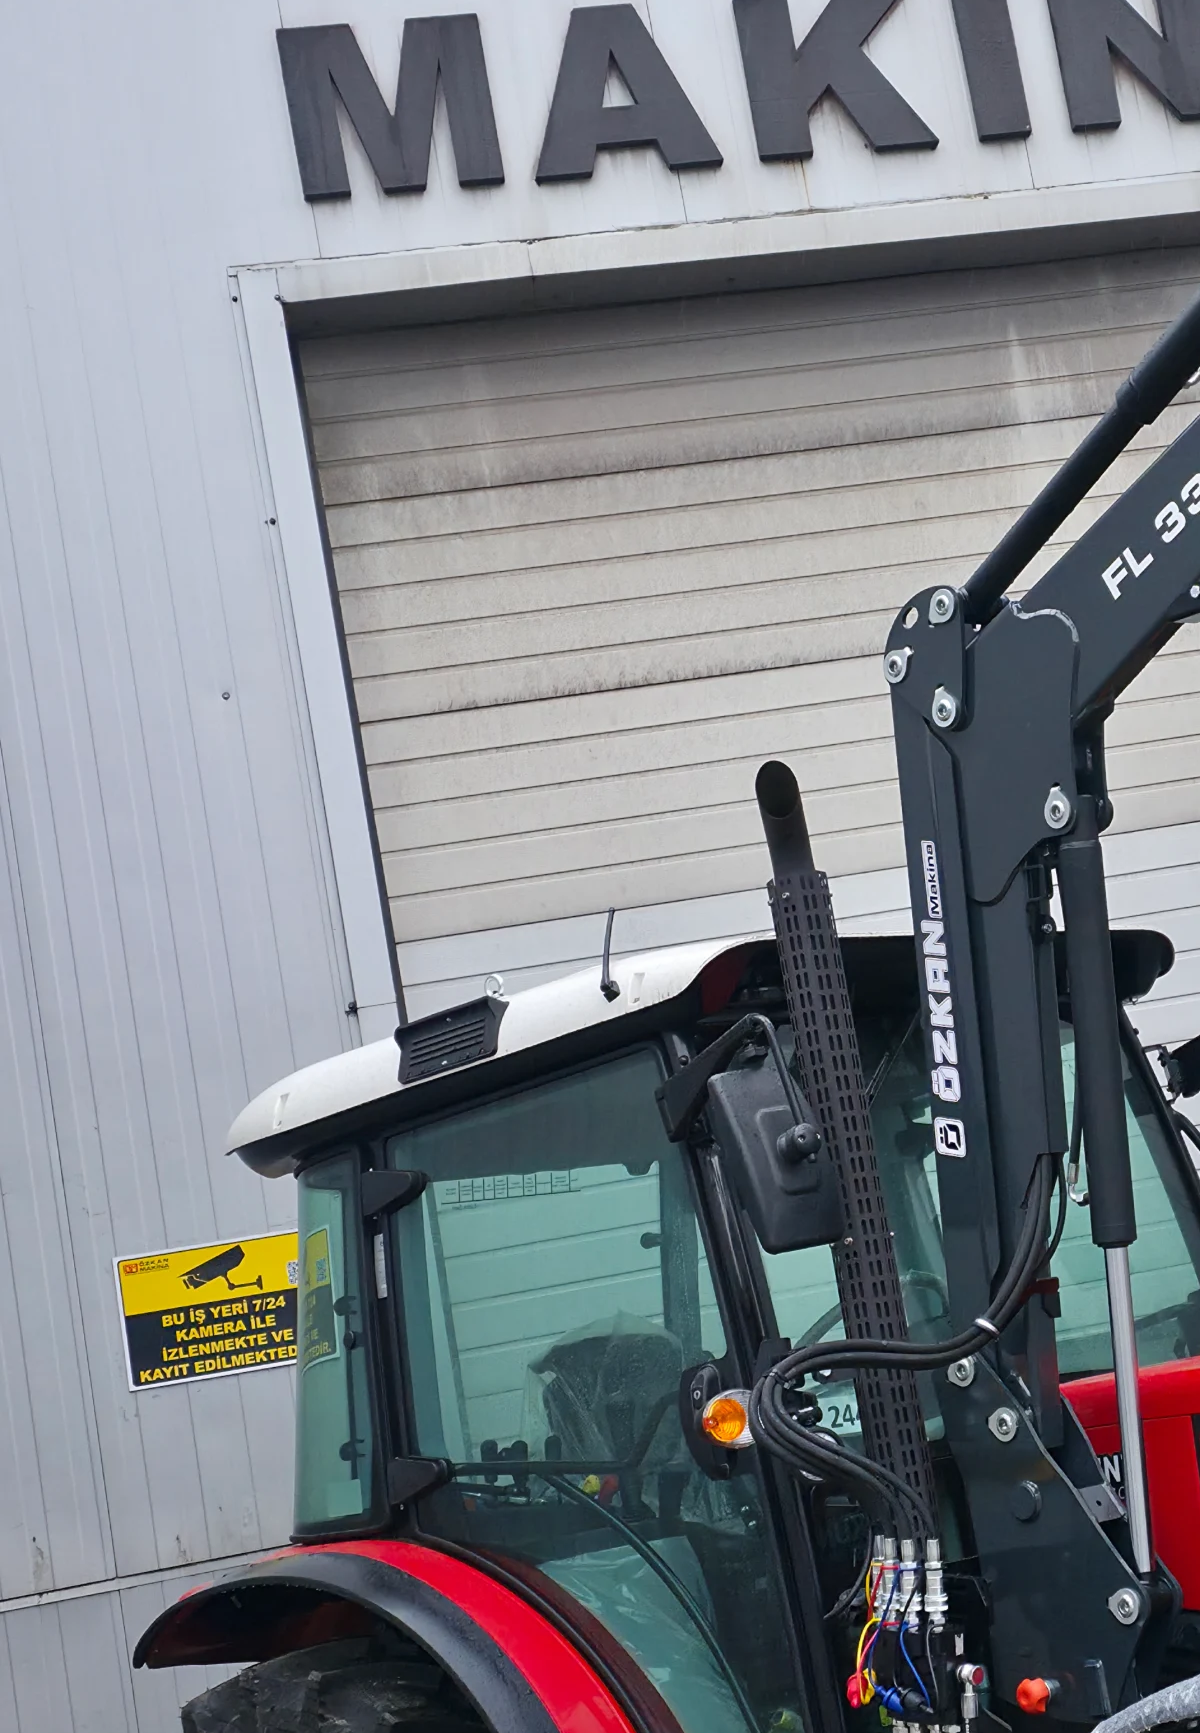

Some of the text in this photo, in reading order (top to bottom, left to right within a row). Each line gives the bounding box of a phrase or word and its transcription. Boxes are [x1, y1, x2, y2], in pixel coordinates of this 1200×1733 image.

[1101, 547, 1154, 601] FL
[925, 843, 940, 916] Makina
[921, 920, 961, 1102] ÖZKAN
[162, 1295, 286, 1327] BU İŞ YERİ 7/24
[176, 1314, 276, 1342] KAMERA İLE
[162, 1329, 294, 1362] İZLENMEKTE VE
[140, 1345, 298, 1383] KAYIT EDİLMEKTED
[828, 1404, 859, 1428] 24
